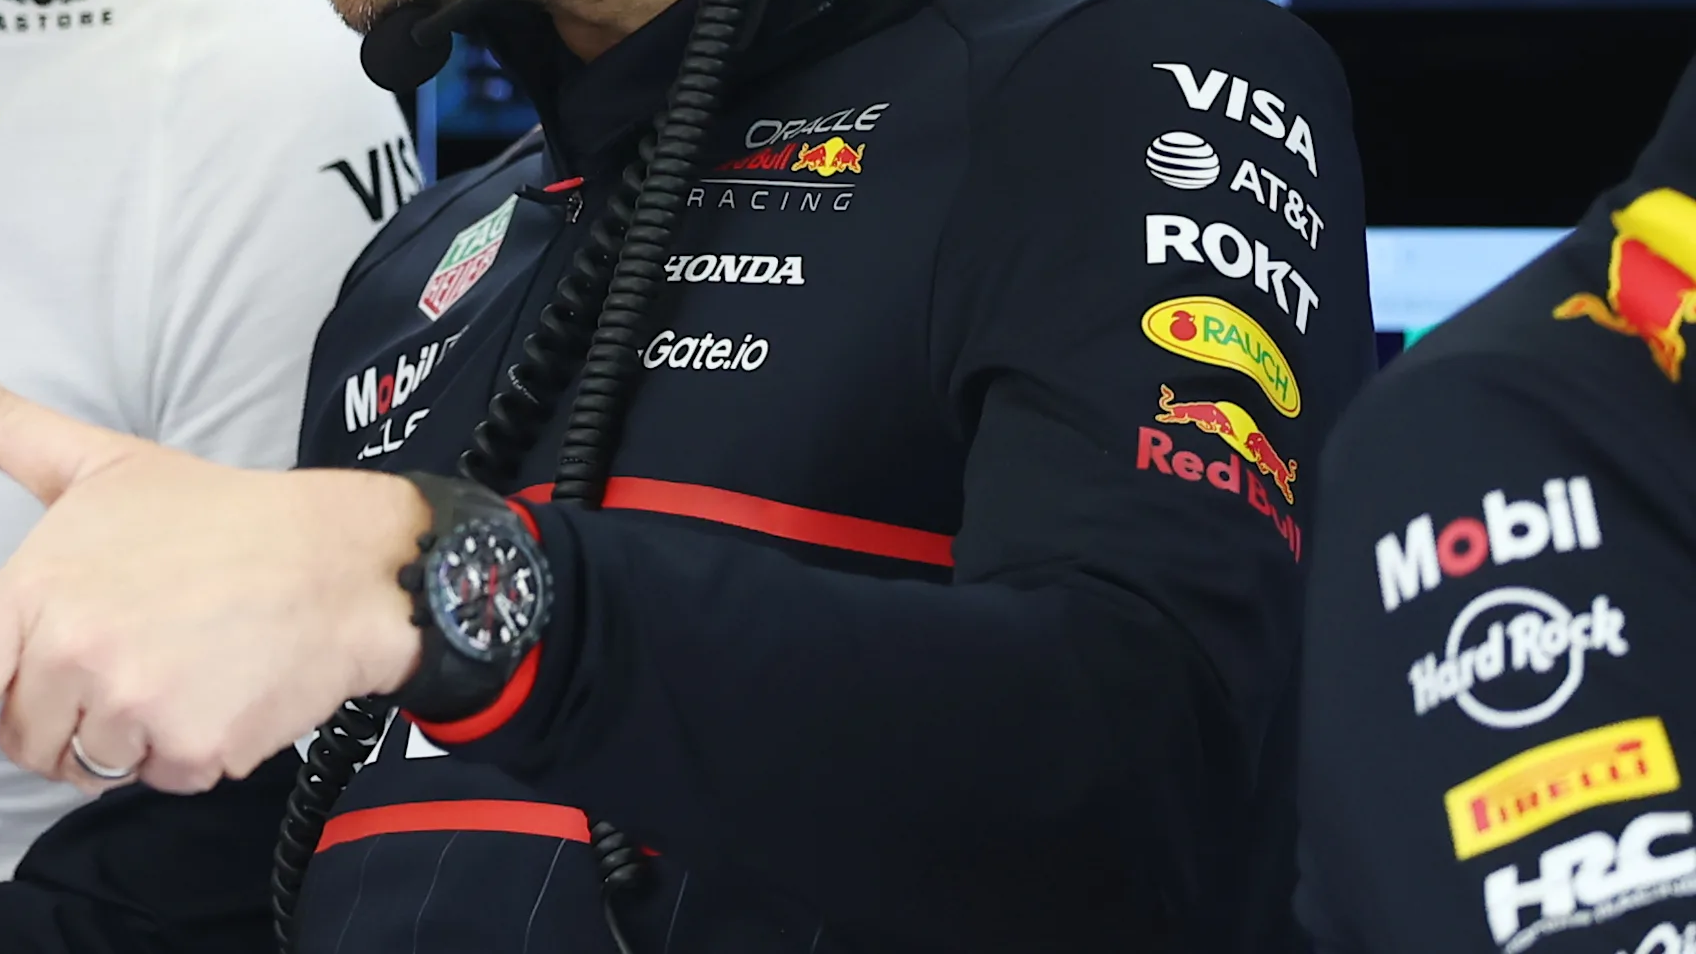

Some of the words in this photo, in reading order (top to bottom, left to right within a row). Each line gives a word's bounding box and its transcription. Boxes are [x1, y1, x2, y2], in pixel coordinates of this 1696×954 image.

[744, 102, 891, 149] ORACLE
[1152, 62, 1318, 178] VISA
[686, 187, 853, 212] RACING
[1229, 159, 1325, 251] AT&T
[1145, 214, 1320, 335] ROKT
[343, 342, 439, 433] Mobil
[642, 330, 769, 372] Gate.io
[1202, 315, 1290, 402] RAUCH
[1136, 426, 1243, 493] Red
[1245, 466, 1301, 564] Bull
[1374, 476, 1603, 612] Mobil
[1407, 622, 1506, 716] Hard
[1506, 595, 1629, 674] Rock
[1469, 735, 1652, 835] PIRELLI
[1484, 810, 1696, 945] HRC
